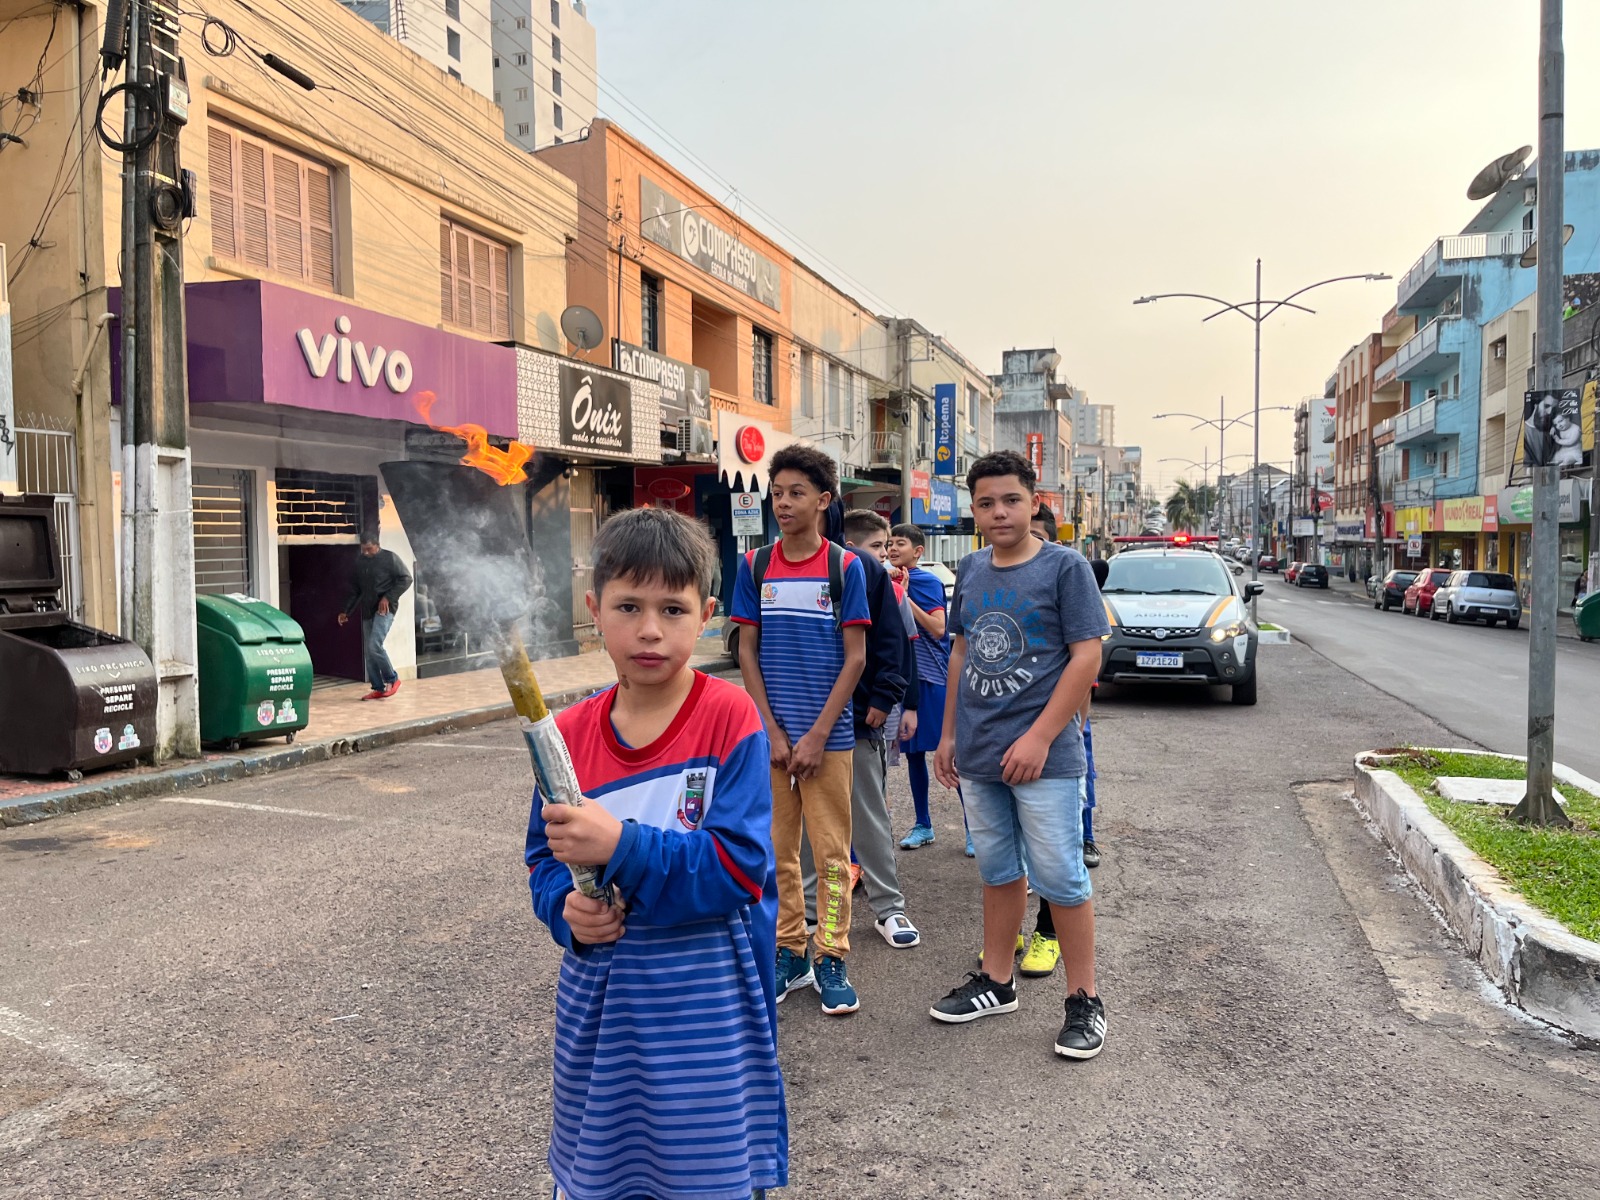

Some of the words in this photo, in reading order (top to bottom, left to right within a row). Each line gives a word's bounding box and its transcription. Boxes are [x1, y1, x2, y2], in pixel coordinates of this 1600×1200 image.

[699, 217, 757, 284] COMPASSO
[296, 315, 413, 393] vivo
[632, 350, 686, 392] COMPASSO
[571, 375, 622, 437] Ônix
[939, 397, 952, 444] itapema
[572, 431, 589, 444] moda
[590, 436, 595, 444] e
[742, 497, 749, 505] E
[266, 667, 297, 676] PRESERVE
[270, 676, 294, 685] SEPARE
[100, 683, 136, 695] PRESERVE
[269, 683, 295, 692] RECICLE
[105, 693, 133, 704] SEPARE
[104, 702, 134, 714] RECICLE
